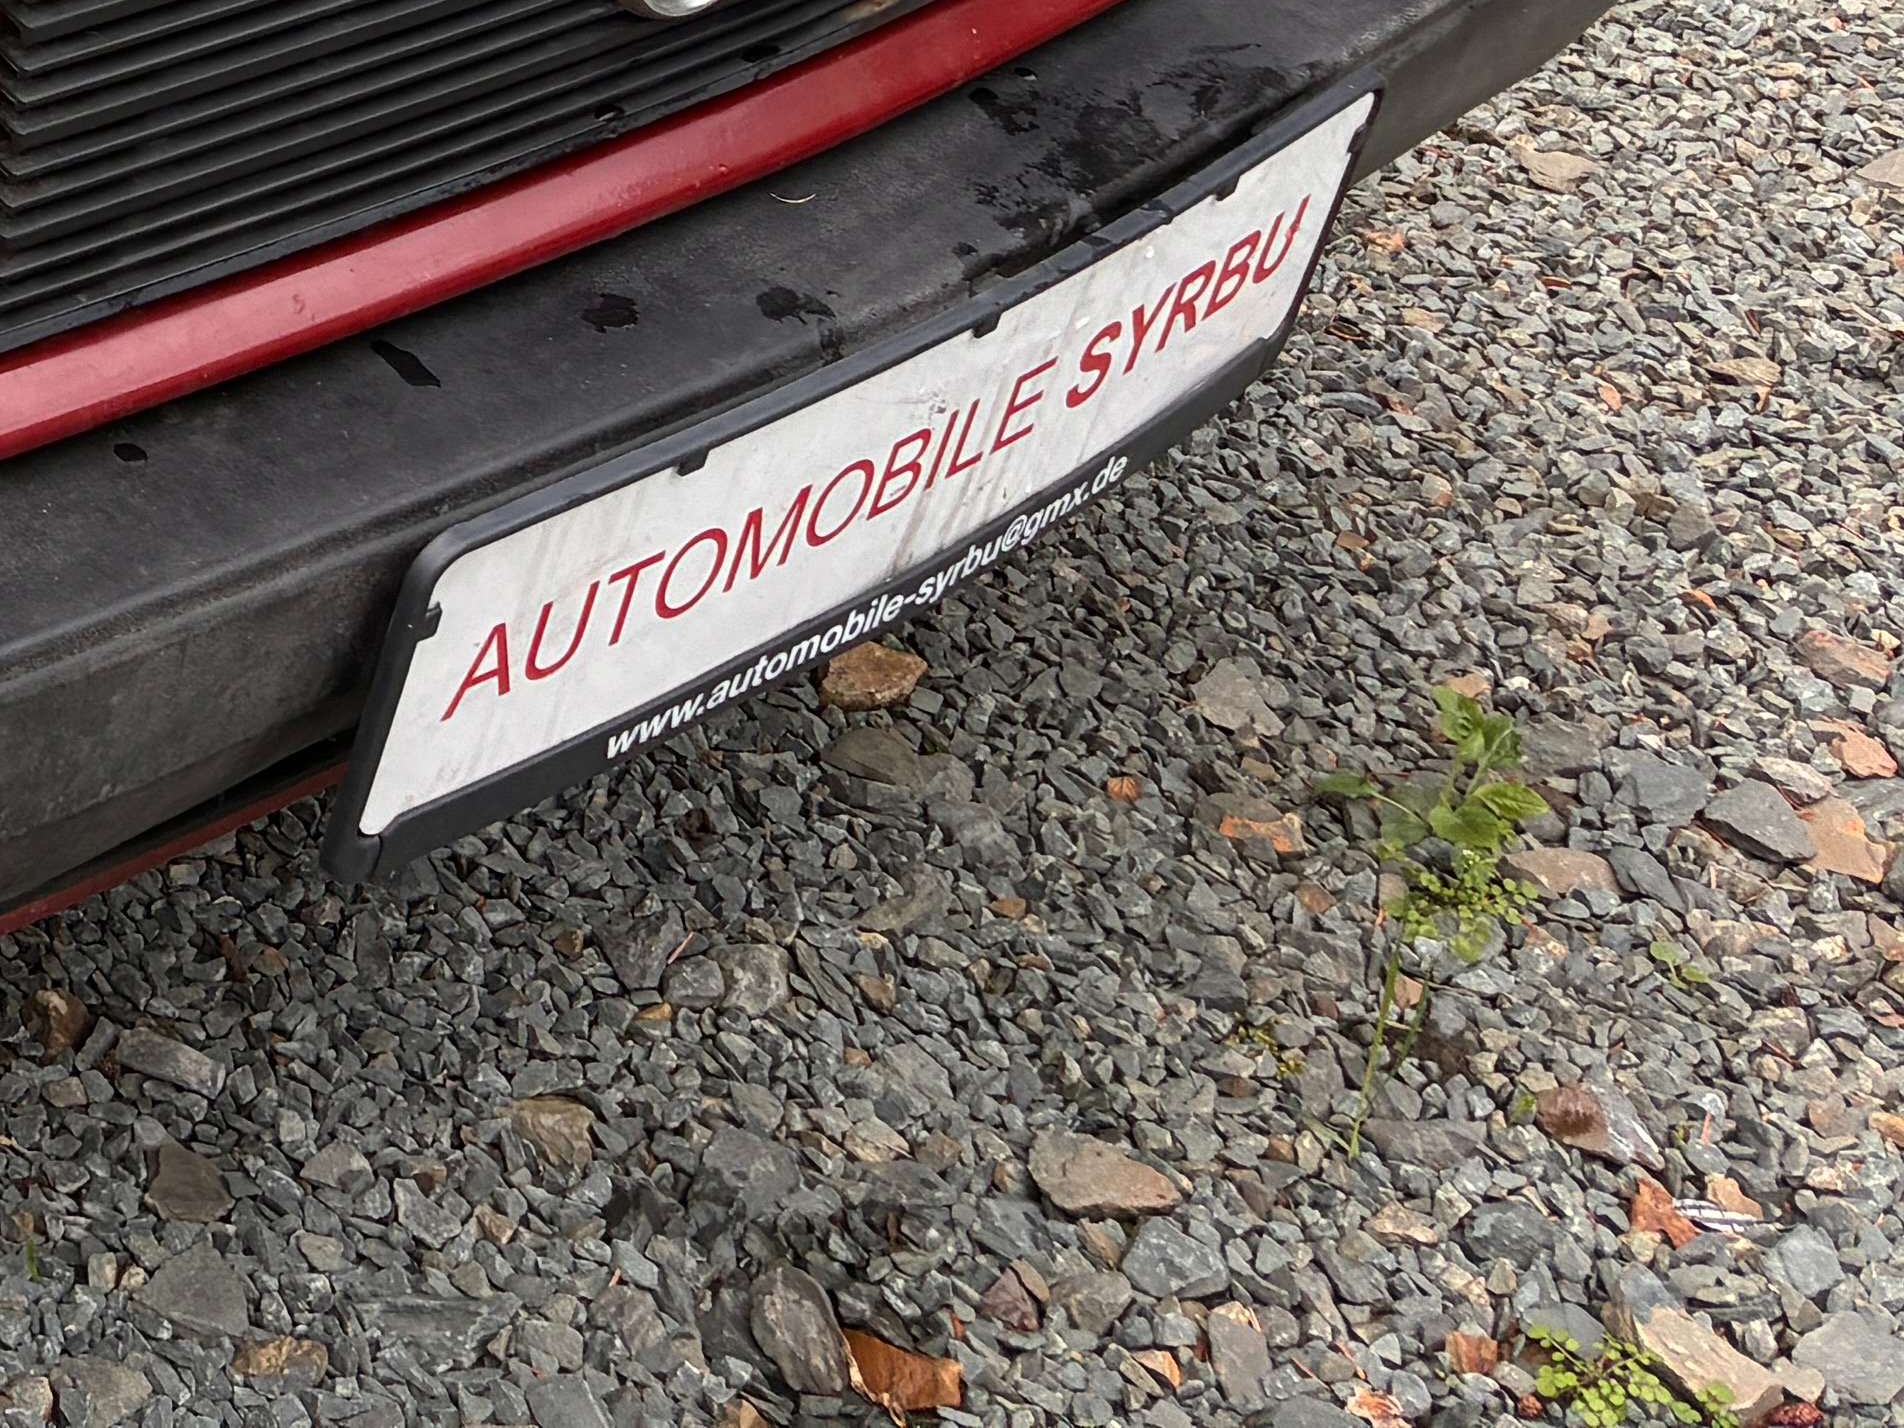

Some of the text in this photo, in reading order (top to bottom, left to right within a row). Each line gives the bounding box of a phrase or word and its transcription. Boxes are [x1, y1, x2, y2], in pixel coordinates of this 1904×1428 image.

[440, 193, 1312, 722] AUTOMOBILE SYRBU
[606, 454, 1128, 761] www.automobile-syrbu@gmx.de
